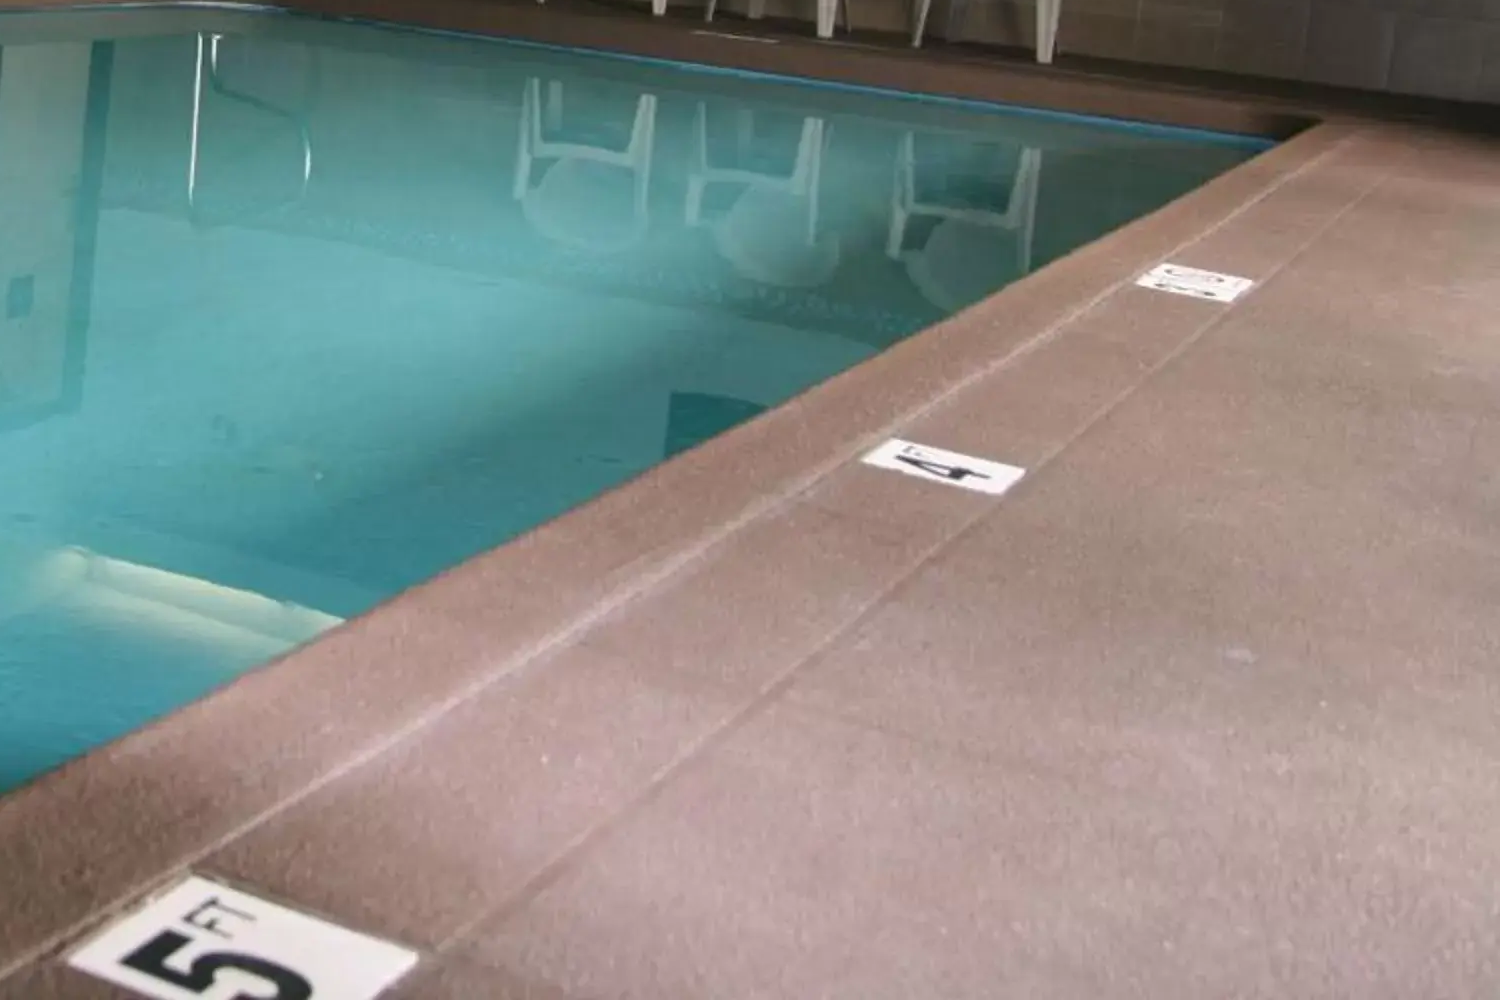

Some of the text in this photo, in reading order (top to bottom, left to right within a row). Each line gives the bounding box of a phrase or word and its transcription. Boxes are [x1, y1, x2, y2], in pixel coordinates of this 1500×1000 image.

[894, 455, 992, 480] 4
[118, 897, 314, 1000] 5 FT
